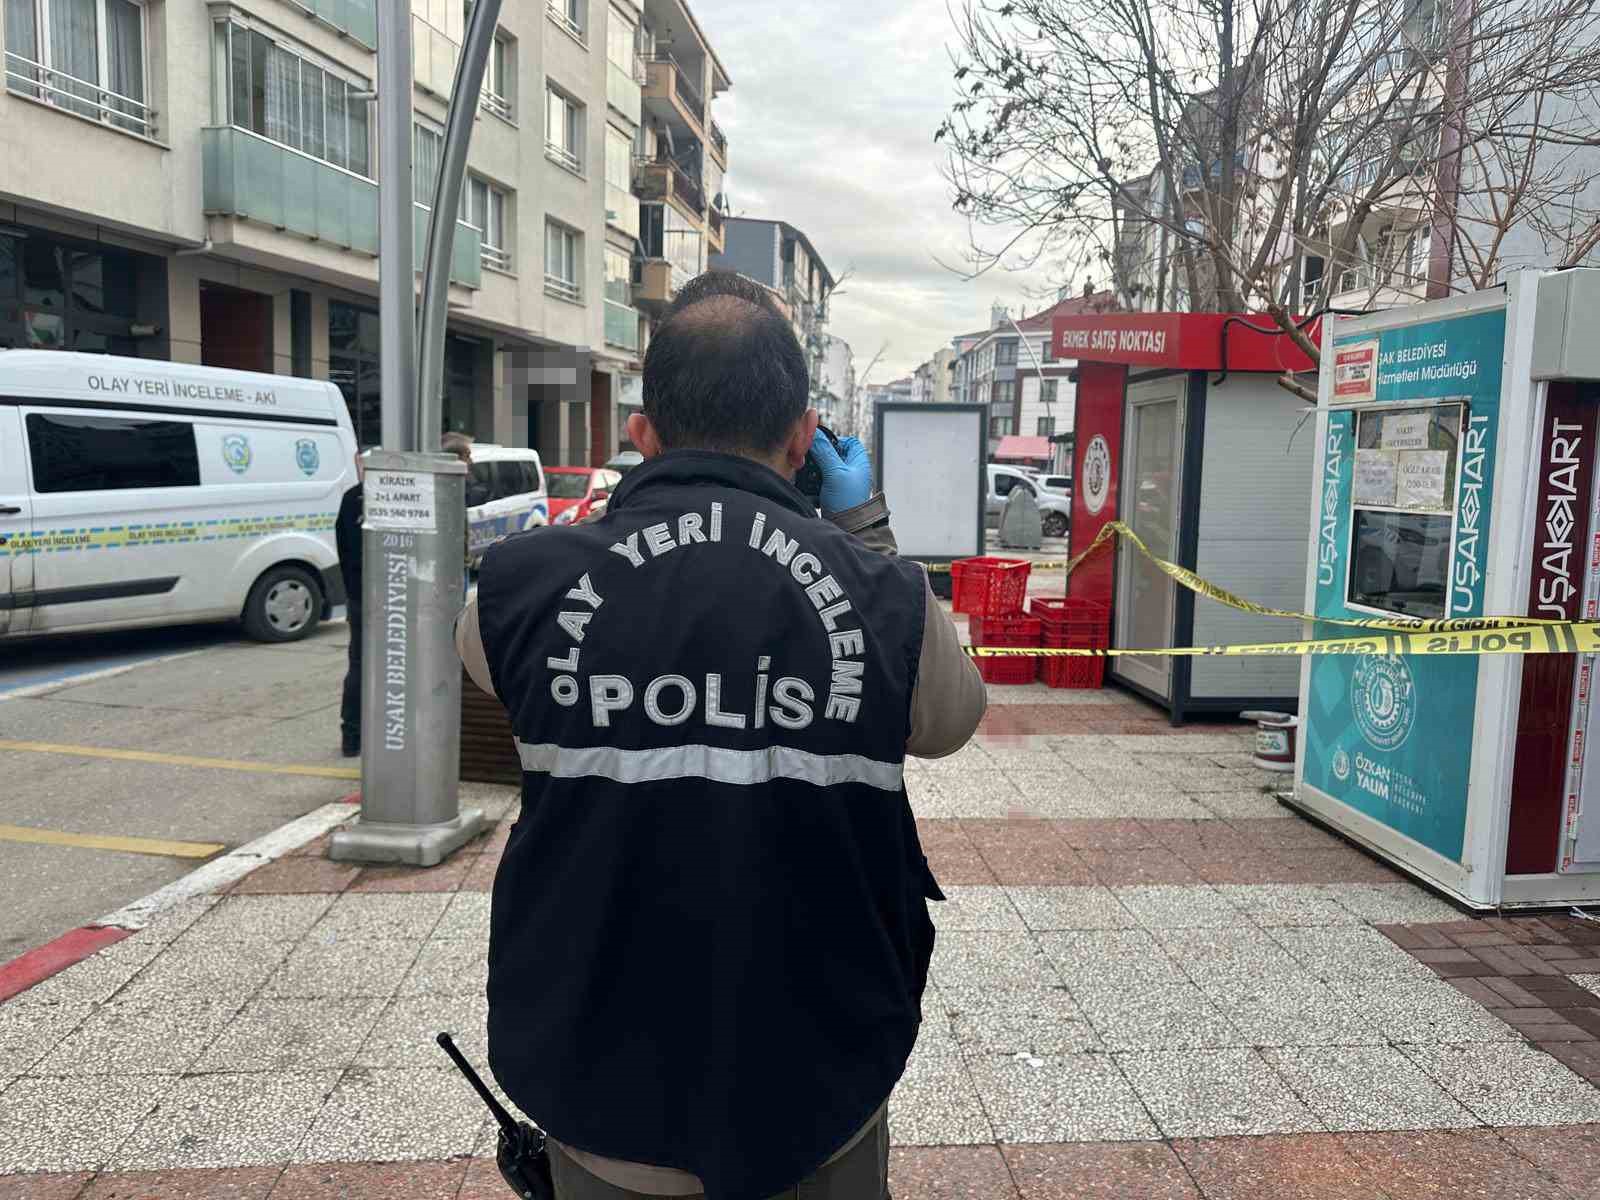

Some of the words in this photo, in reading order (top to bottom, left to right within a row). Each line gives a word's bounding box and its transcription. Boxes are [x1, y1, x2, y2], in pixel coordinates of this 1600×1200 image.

[1062, 330, 1089, 348] EKMEK
[1091, 330, 1117, 352] SATIŞ
[1119, 330, 1166, 352] NOKTASI
[1397, 340, 1447, 362] BELEDİYESİ
[1421, 360, 1477, 380] Müdürlüğü
[88, 375, 130, 393] OLAY
[133, 378, 170, 397] YERİ
[172, 381, 245, 402] İNCELEME
[255, 390, 277, 406] AKİ
[379, 476, 416, 487] KİRALIK
[376, 492, 390, 501] 2+1
[393, 493, 421, 502] APART
[384, 552, 407, 685] BELEDİYESİ
[547, 572, 603, 707] OLAY
[608, 502, 722, 568] YERİ
[748, 512, 865, 723] İNCELEME
[589, 656, 815, 730] POLİS
[1355, 752, 1390, 782] ÖZKAN
[1356, 771, 1389, 800] YALIM
